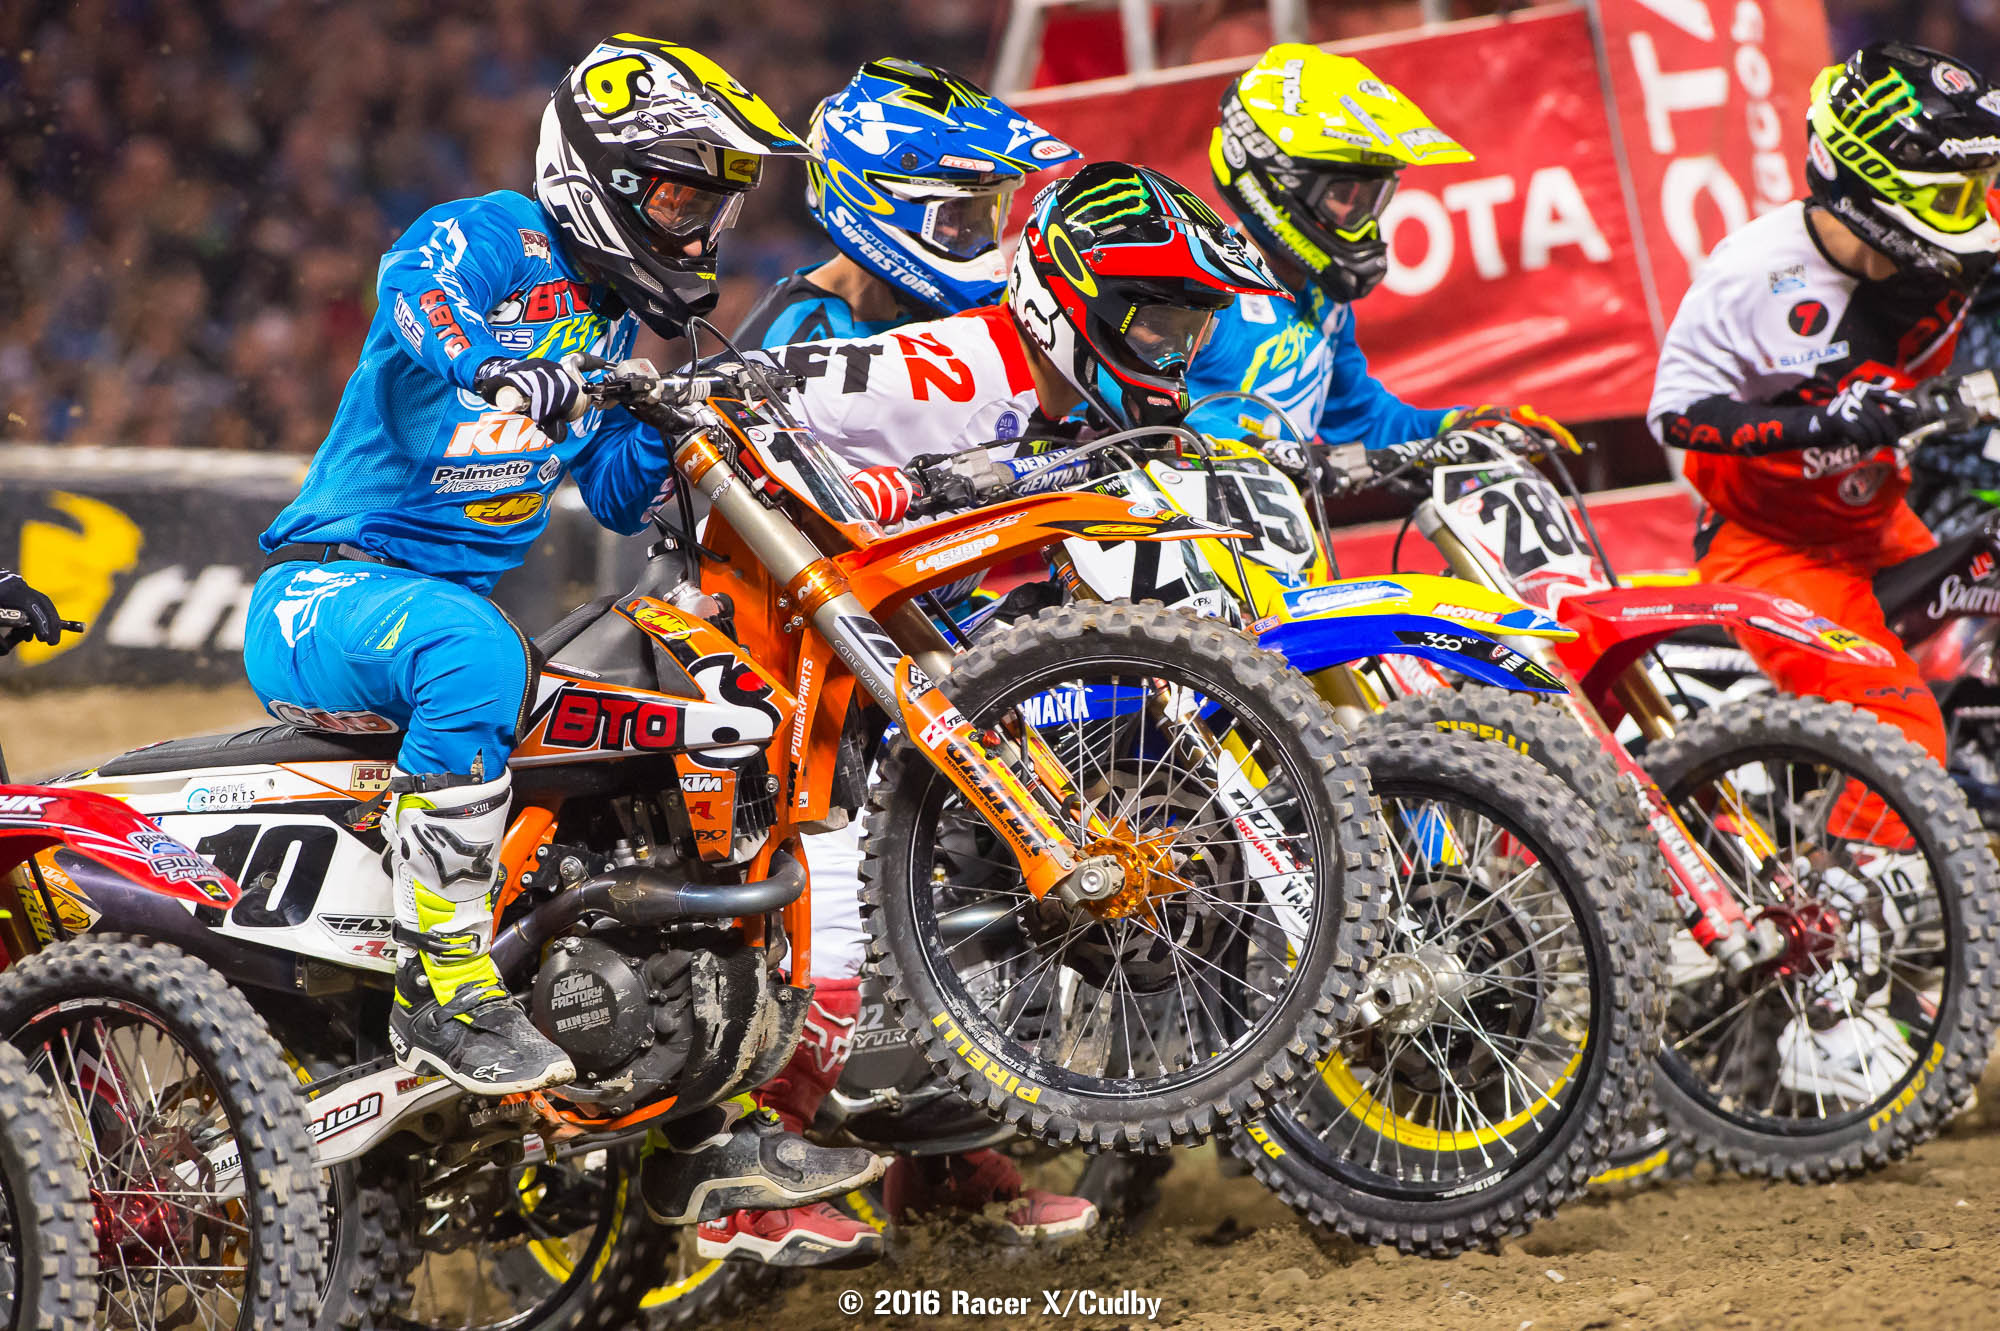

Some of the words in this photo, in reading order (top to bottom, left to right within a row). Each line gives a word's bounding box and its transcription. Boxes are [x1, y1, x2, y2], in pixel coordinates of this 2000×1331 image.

[1119, 305, 1137, 335] OAKLEY
[1796, 302, 1821, 336] 7
[434, 461, 531, 483] Palmetto
[634, 608, 691, 639] FMF
[1253, 617, 1281, 633] GET
[1419, 631, 1463, 652] 360
[1461, 635, 1479, 646] FLY
[549, 693, 680, 749] BTO
[681, 773, 722, 792] KTM
[201, 790, 256, 804] SPORTS
[943, 755, 985, 798] PERFORMANCE
[984, 797, 1008, 828] BRAKING
[1006, 826, 1032, 859] SYSTEMS
[195, 823, 338, 928] 10
[551, 985, 603, 1010] FACTORY
[553, 973, 593, 998] KTM
[556, 1007, 610, 1030] HINSON
[931, 1010, 1044, 1105] PIRELLI
